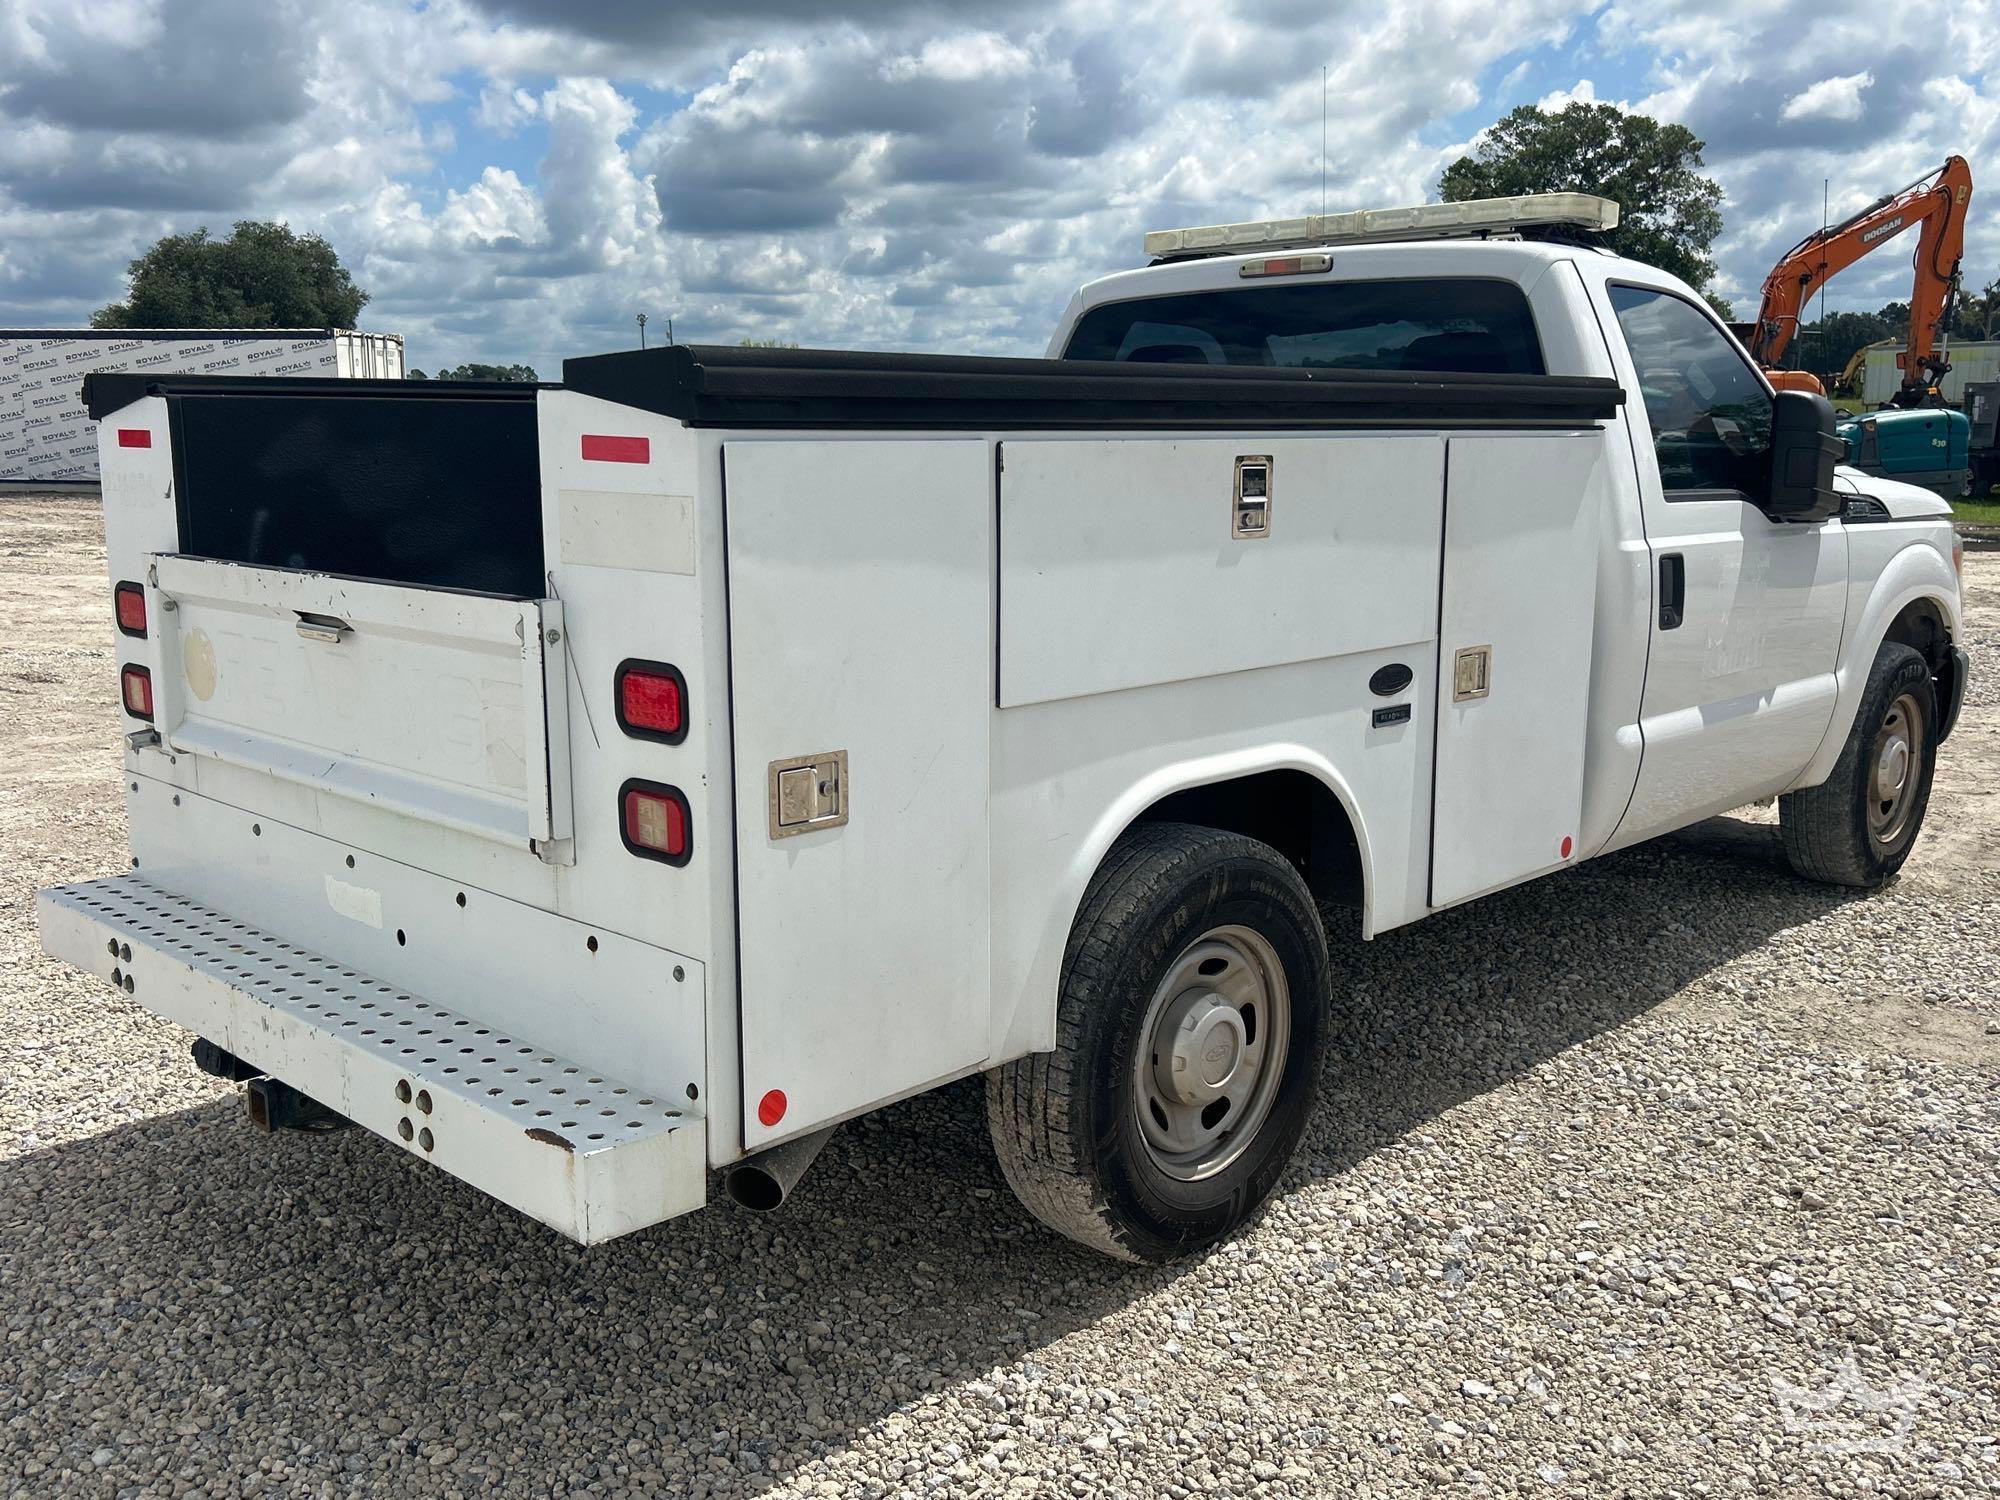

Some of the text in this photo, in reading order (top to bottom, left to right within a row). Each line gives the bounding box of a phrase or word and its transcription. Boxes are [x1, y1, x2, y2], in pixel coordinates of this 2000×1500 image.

[1863, 218, 1901, 242] DOOSAN
[108, 341, 136, 351] ROYAL
[179, 345, 207, 355] ROYAL
[292, 340, 320, 350] ROYAL
[3, 354, 18, 362] ROY
[65, 351, 93, 360] ROYAL
[136, 354, 162, 364] ROYAL
[248, 350, 276, 360] ROYAL
[320, 354, 337, 363] ROY
[23, 360, 50, 369] ROYAL
[93, 364, 120, 374] ROYAL
[204, 360, 232, 369] ROYAL
[275, 363, 304, 373] ROYAL
[50, 372, 78, 383] ROYAL
[21, 381, 35, 389] YAL
[32, 395, 59, 405] ROYAL
[0, 410, 21, 419] OYAL
[60, 409, 87, 419] ROYAL
[25, 417, 45, 426] OYAL
[42, 431, 69, 441] ROYAL
[4, 447, 28, 456] ROYA
[69, 444, 95, 454] ROYAL
[28, 452, 54, 463] ROYAL
[1, 466, 16, 475] YAL
[52, 465, 79, 476] ROYAL
